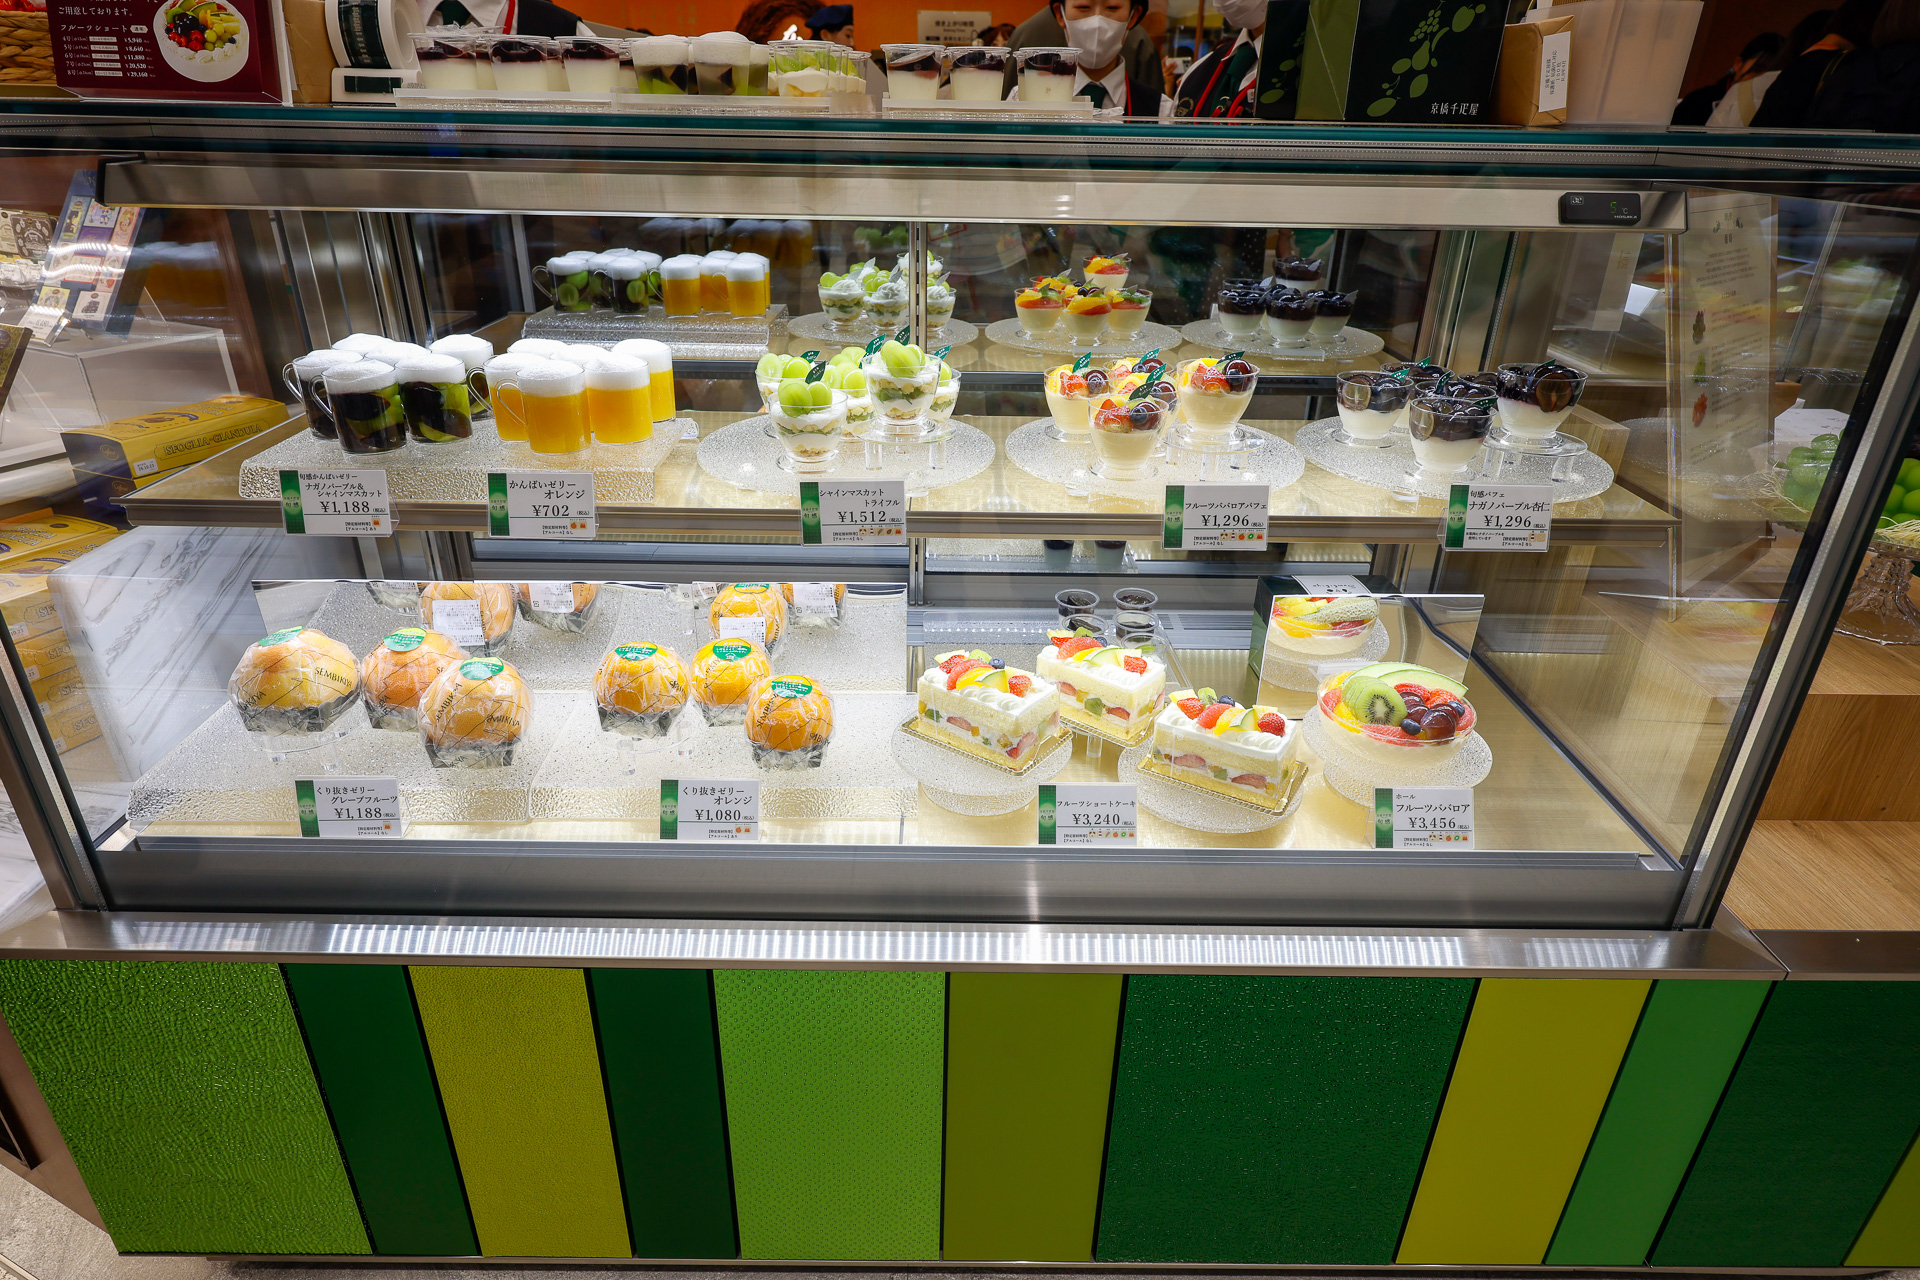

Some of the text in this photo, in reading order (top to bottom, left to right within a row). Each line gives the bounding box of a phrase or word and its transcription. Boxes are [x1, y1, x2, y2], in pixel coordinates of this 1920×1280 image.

[58, 6, 132, 16] ご用意しております。
[60, 24, 128, 32] フルーツショート
[1430, 102, 1479, 116] 京橋千疋屋
[1611, 202, 1617, 213] 5
[544, 490, 585, 499] オレンジ
[320, 501, 370, 514] ¥1,188
[532, 505, 570, 516] ¥702
[838, 511, 886, 524] ¥1,512
[1201, 515, 1249, 527] ¥1,296
[1484, 515, 1531, 528] ¥1,296
[317, 787, 375, 795] くり抜きゼリー
[683, 787, 744, 796] くり抜きゼリー
[331, 796, 397, 804] グレープフルーツ
[714, 796, 752, 805] オレンジ
[334, 808, 382, 820] ¥1,188
[695, 810, 741, 822] ¥1,080
[1072, 814, 1120, 826] ¥3,240
[1409, 817, 1456, 830] ¥3,456
